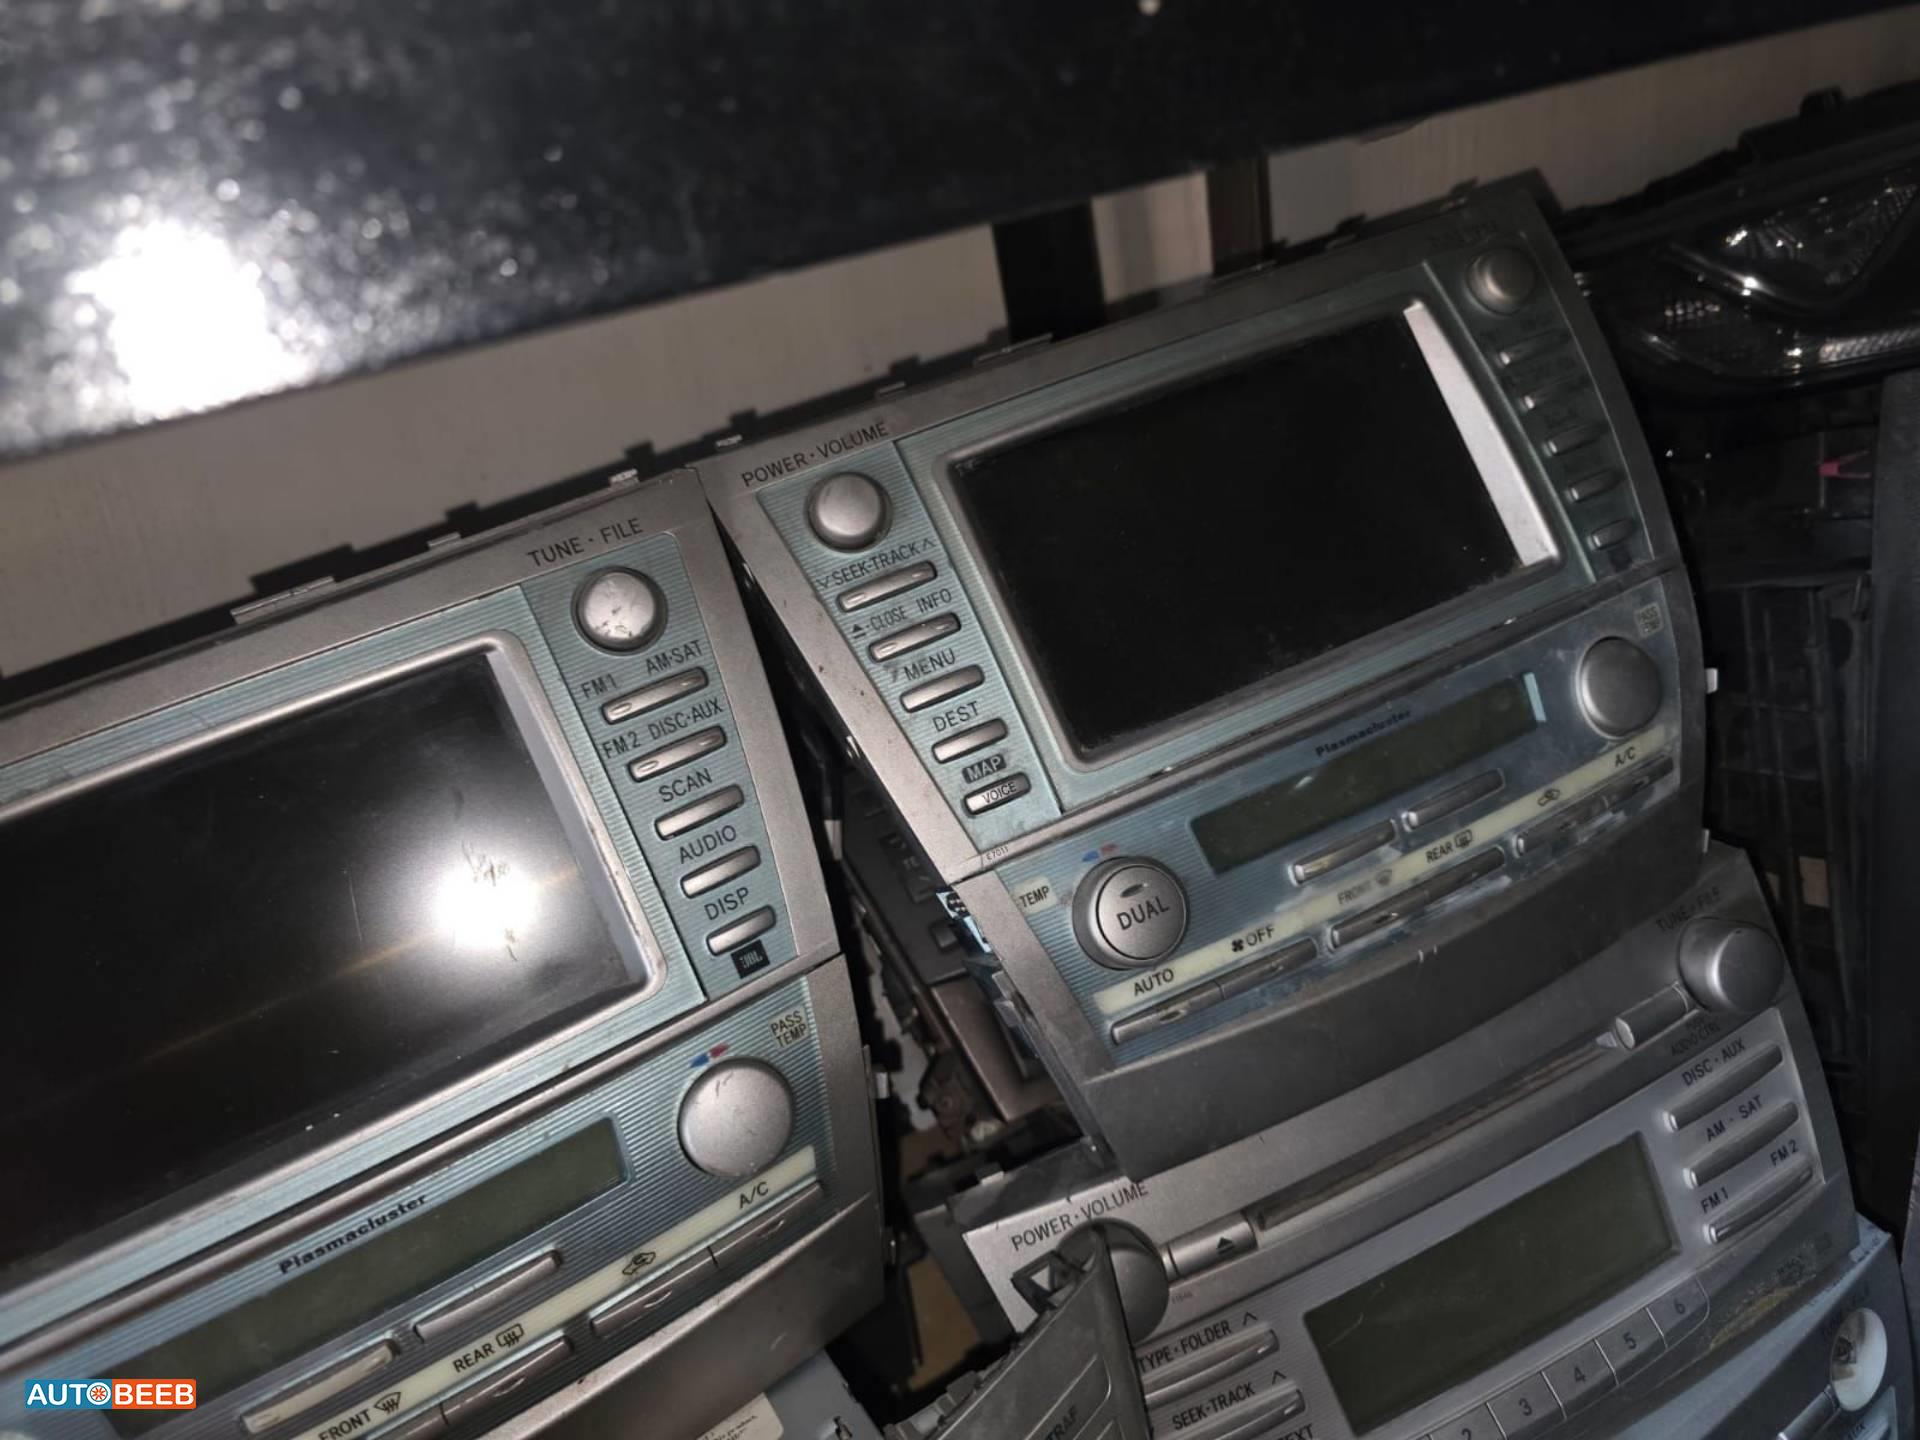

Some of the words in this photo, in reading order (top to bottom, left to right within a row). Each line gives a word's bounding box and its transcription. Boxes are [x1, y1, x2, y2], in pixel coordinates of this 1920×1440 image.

[915, 588, 952, 615] INFO
[904, 648, 956, 682] MENU
[932, 701, 981, 733] DEST
[1314, 709, 1412, 757] Plasmacluster
[966, 755, 1004, 781] MAP
[1614, 745, 1638, 769] A/C
[657, 768, 713, 803] SCAN
[982, 780, 1018, 804] VOICE
[678, 824, 738, 864] AUDIO
[1425, 841, 1454, 863] REAR
[704, 887, 750, 921] DISP
[1019, 886, 1050, 908] TEMP
[1116, 895, 1171, 930] DUAL
[1246, 923, 1277, 947] OFF
[1131, 967, 1175, 996] AUTO
[770, 1010, 803, 1035] PASS
[776, 1023, 807, 1048] TEMP
[1739, 1095, 1764, 1120] SAT
[737, 1179, 770, 1209] A/C
[279, 1193, 428, 1276] Plasmacluster
[1674, 1299, 1686, 1315] 6
[1623, 1330, 1637, 1351] 5
[452, 1341, 496, 1373] REAR
[1574, 1366, 1587, 1384] 4
[1519, 1397, 1533, 1417] 3
